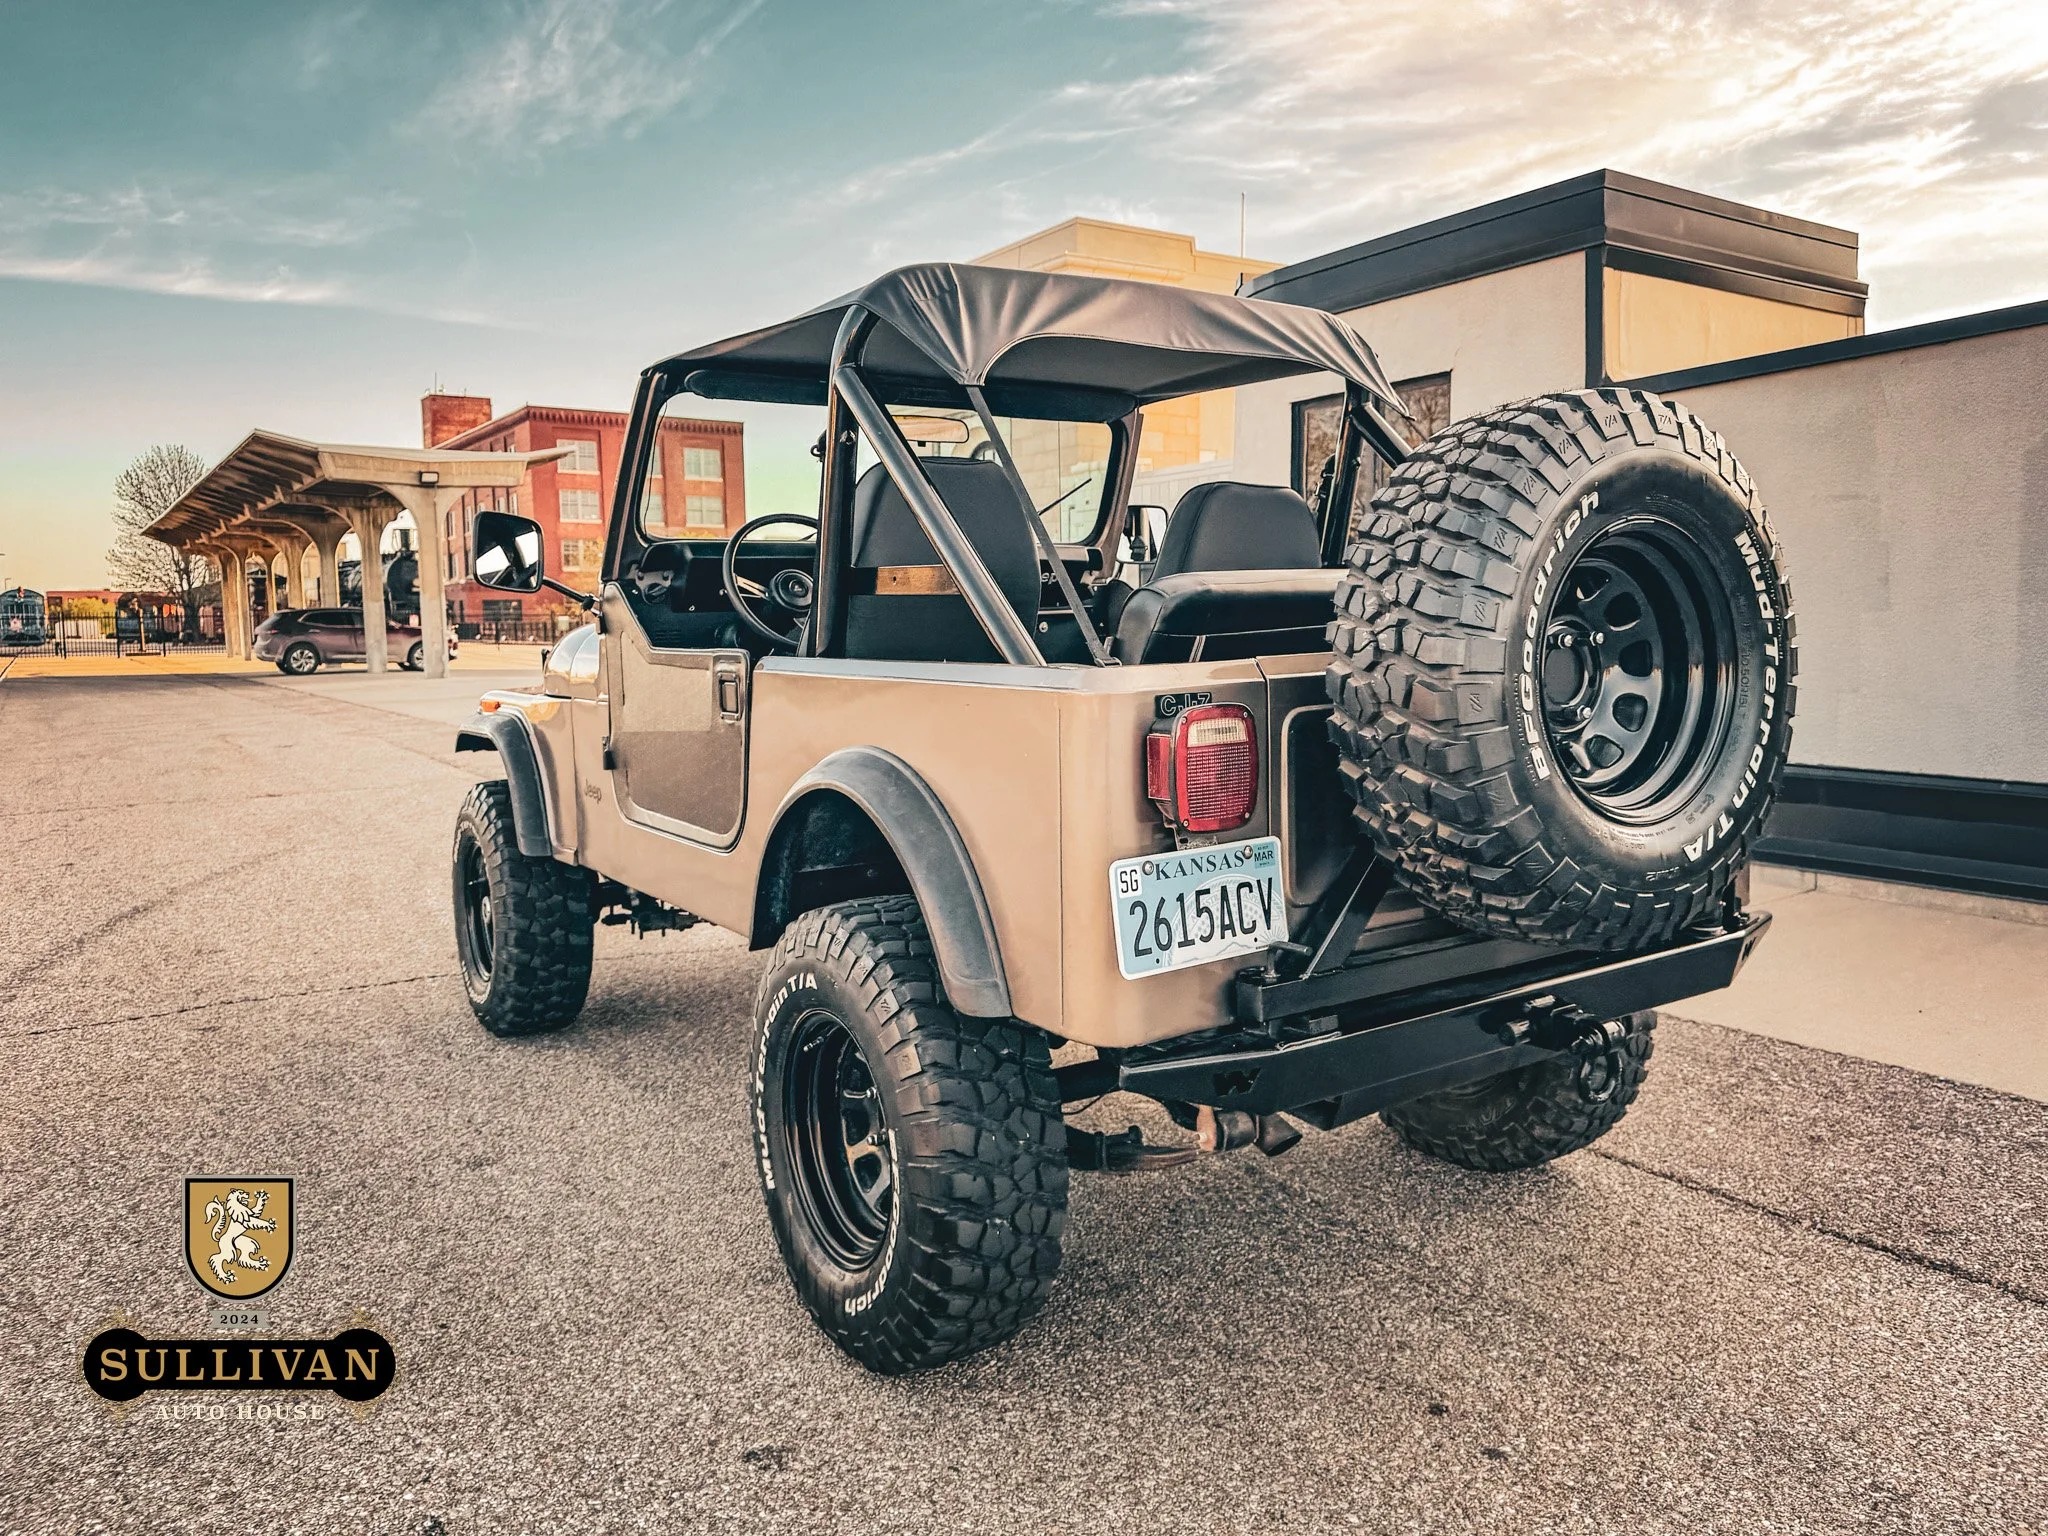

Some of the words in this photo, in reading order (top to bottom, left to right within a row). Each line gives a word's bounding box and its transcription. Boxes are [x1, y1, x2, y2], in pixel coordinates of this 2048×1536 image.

[1520, 489, 1600, 780] BFGoodrich
[1732, 529, 1779, 809] Mud-Terrain
[584, 778, 602, 804] Jeep
[1253, 850, 1274, 862] MAR
[1682, 811, 1735, 862] T/A
[1119, 869, 1139, 894] SG
[1155, 850, 1244, 881] KANSAS
[1129, 877, 1273, 957] 2615ACV
[755, 985, 789, 1190] Mud-Terrain
[788, 972, 818, 990] T/A
